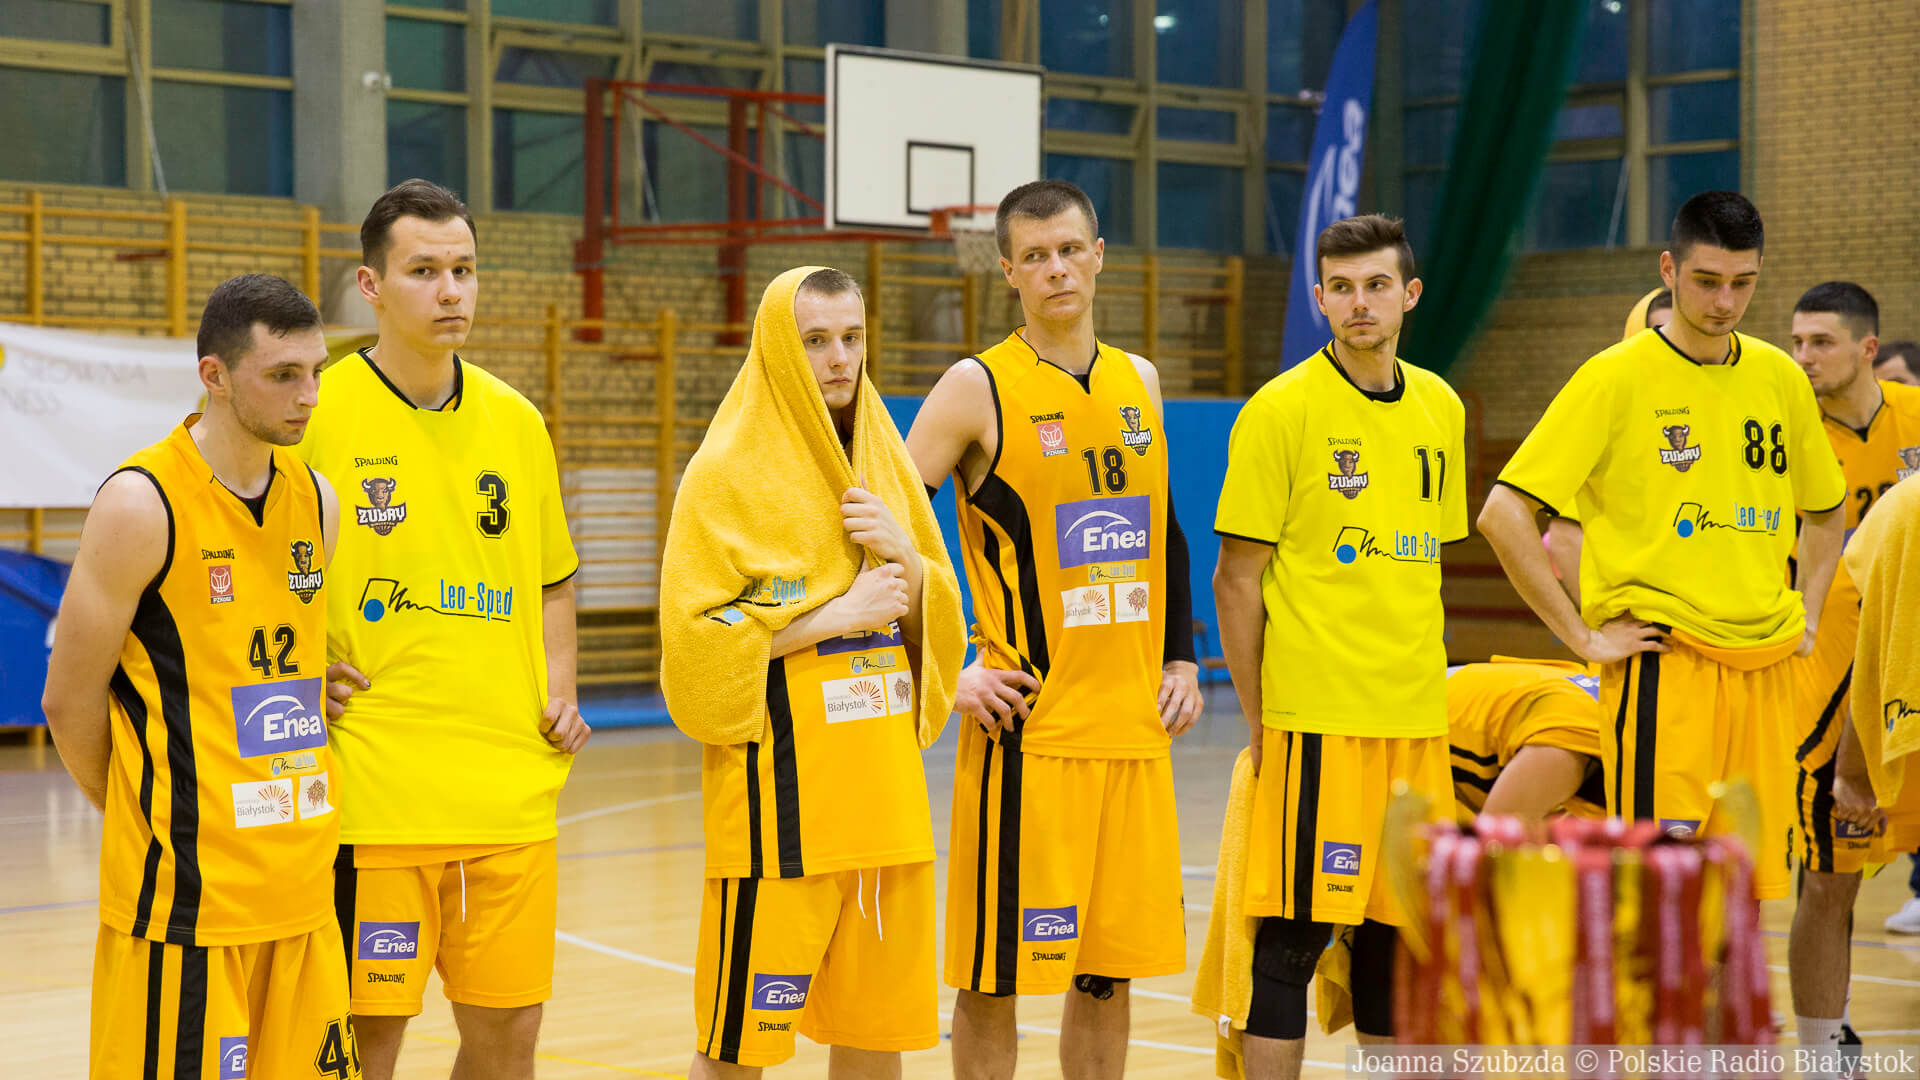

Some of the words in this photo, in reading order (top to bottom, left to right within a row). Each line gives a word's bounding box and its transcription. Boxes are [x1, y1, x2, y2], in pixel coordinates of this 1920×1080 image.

[1331, 98, 1365, 224] nea
[1741, 416, 1788, 478] 88
[355, 456, 398, 467] SPALDING
[1081, 446, 1128, 495] 18
[476, 470, 511, 539] 3
[1083, 527, 1147, 552] Enea
[201, 548, 235, 560] SPALDING
[440, 579, 513, 622] Leo-Sped
[247, 623, 301, 679] 42
[827, 699, 868, 713] Białystok
[263, 712, 322, 742] Enea
[1034, 922, 1075, 936] Enea
[373, 938, 415, 954] Enea
[1032, 952, 1067, 961] SPALDING
[367, 973, 405, 983] SPALDING
[765, 989, 806, 1004] Enea
[231, 1054, 248, 1072] En
